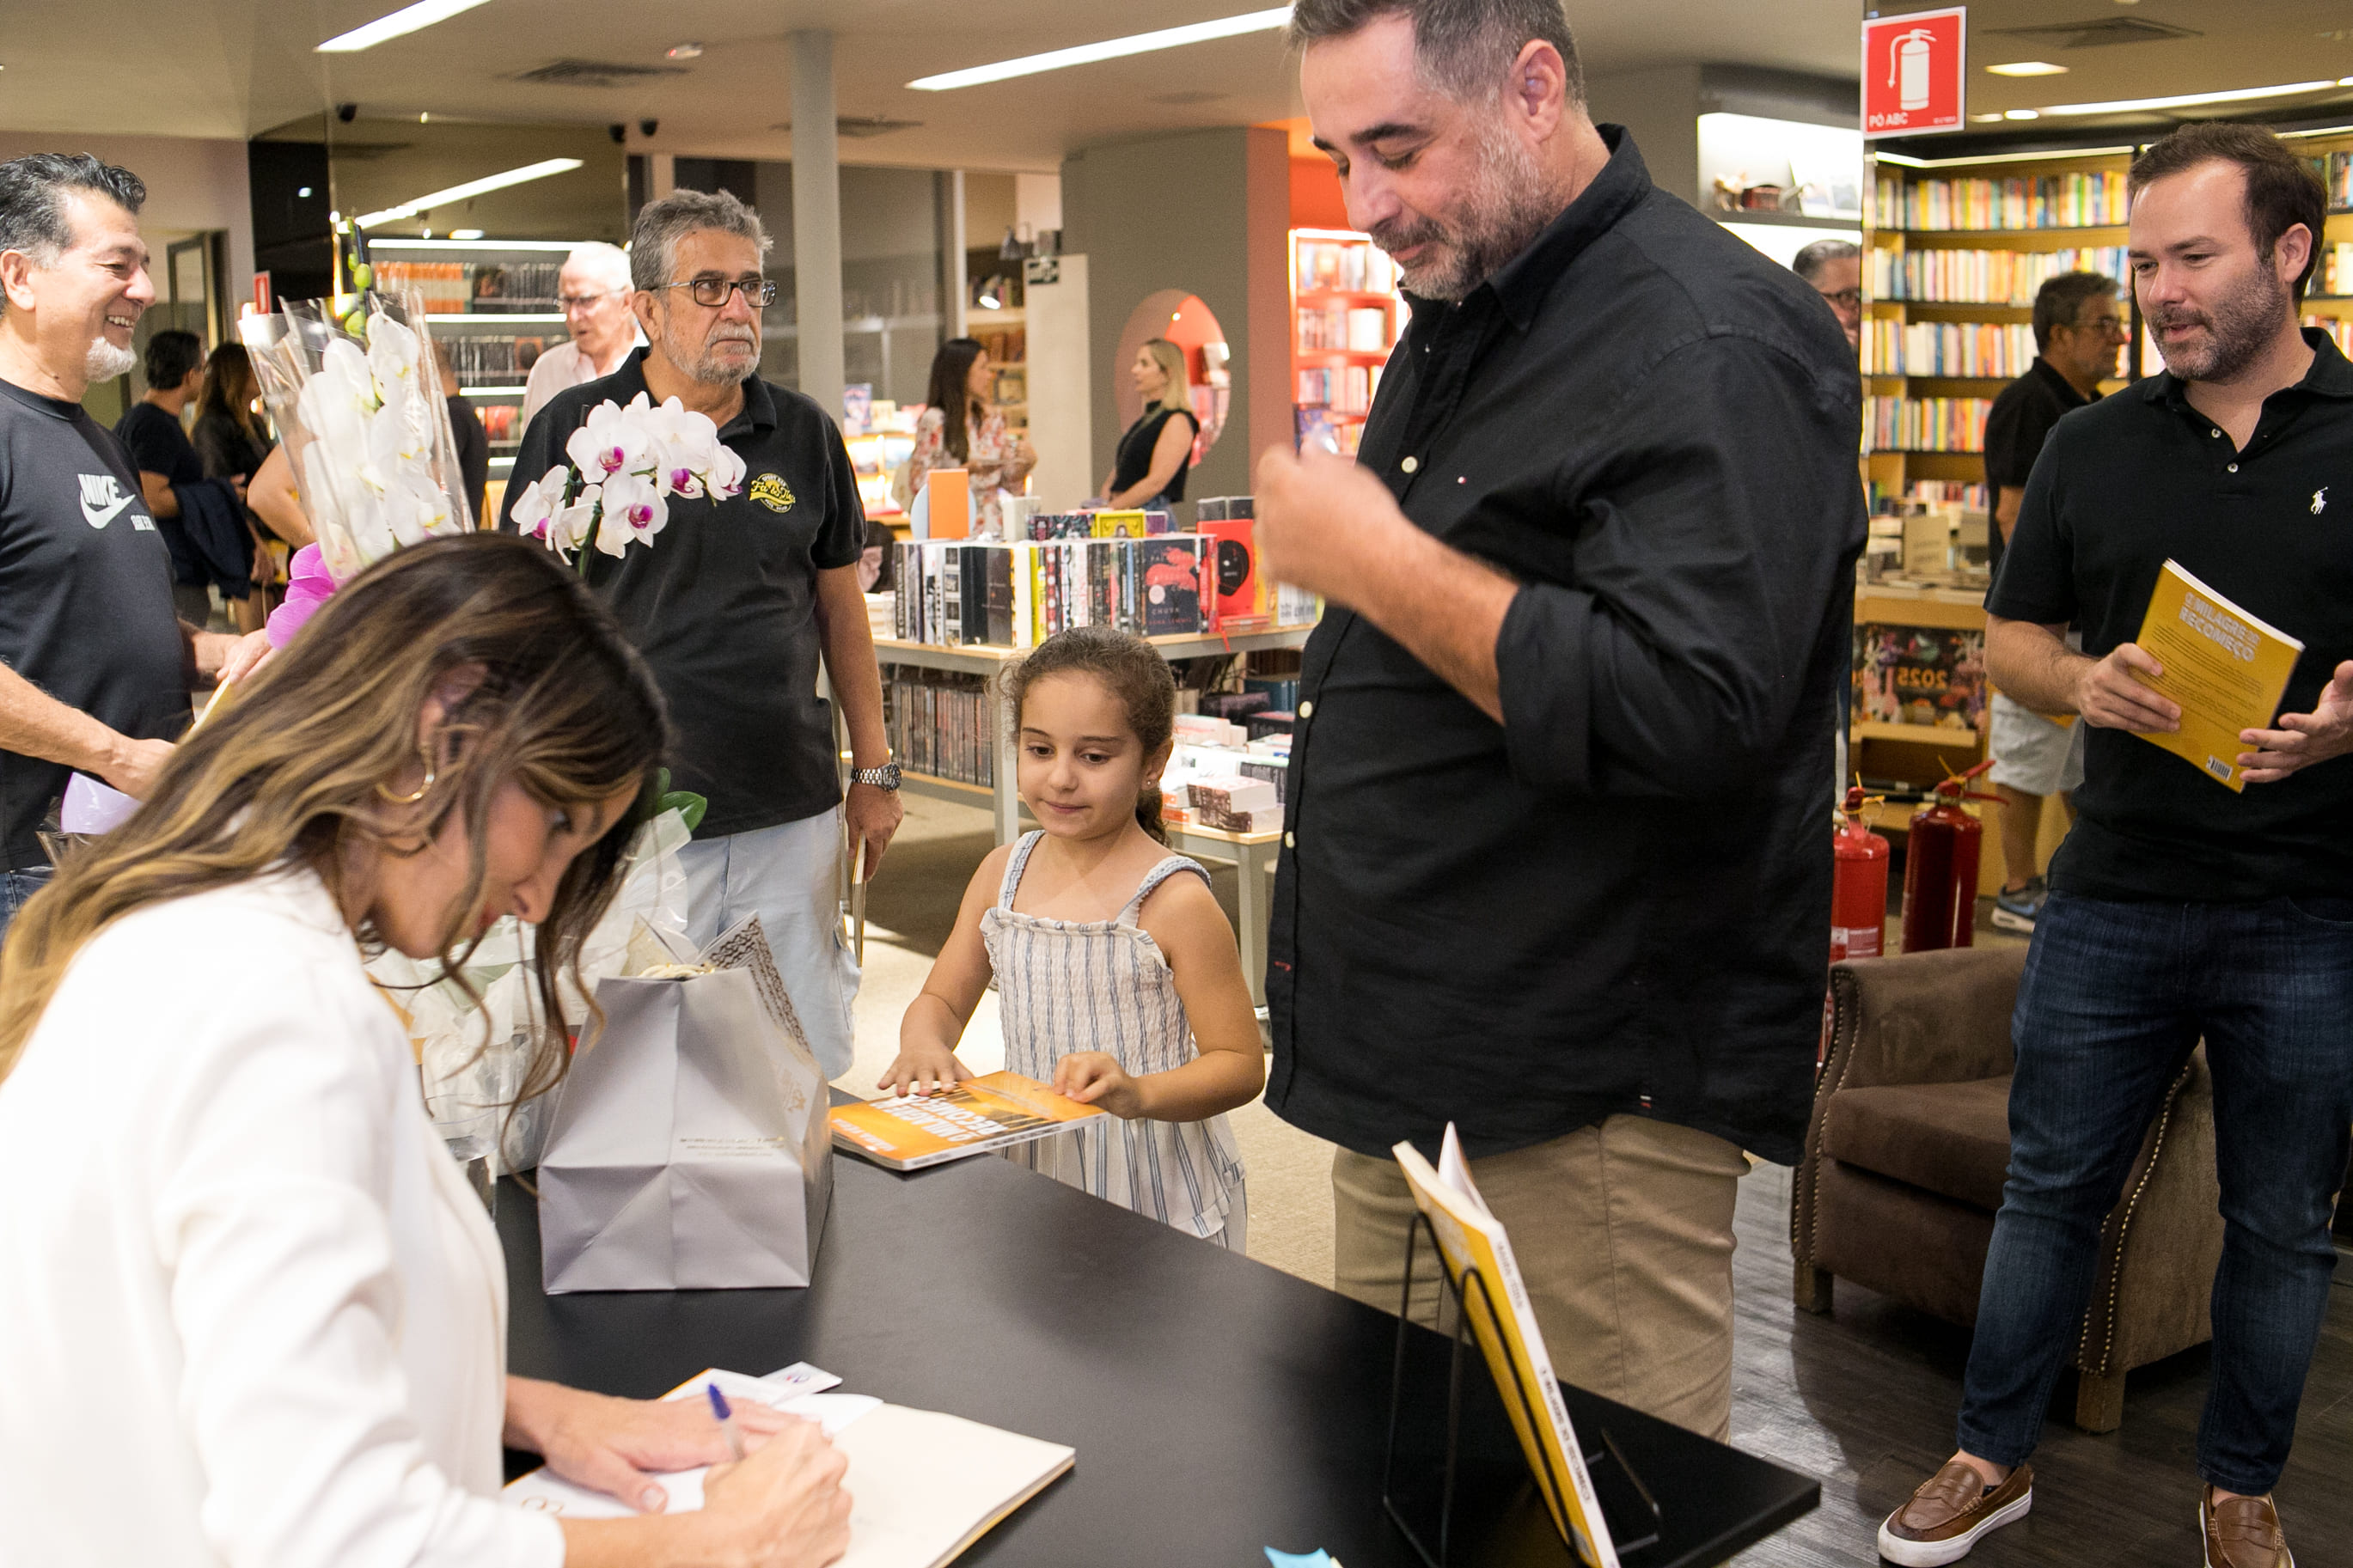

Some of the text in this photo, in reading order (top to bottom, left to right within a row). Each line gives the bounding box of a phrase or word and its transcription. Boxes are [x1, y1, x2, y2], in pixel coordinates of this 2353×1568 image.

[1885, 112, 1909, 126] ABC
[77, 473, 121, 507] NIKE
[2179, 605, 2255, 662] RECOMEÇO
[2194, 597, 2246, 641] MILAGRE
[882, 1105, 968, 1138] MILAGRE
